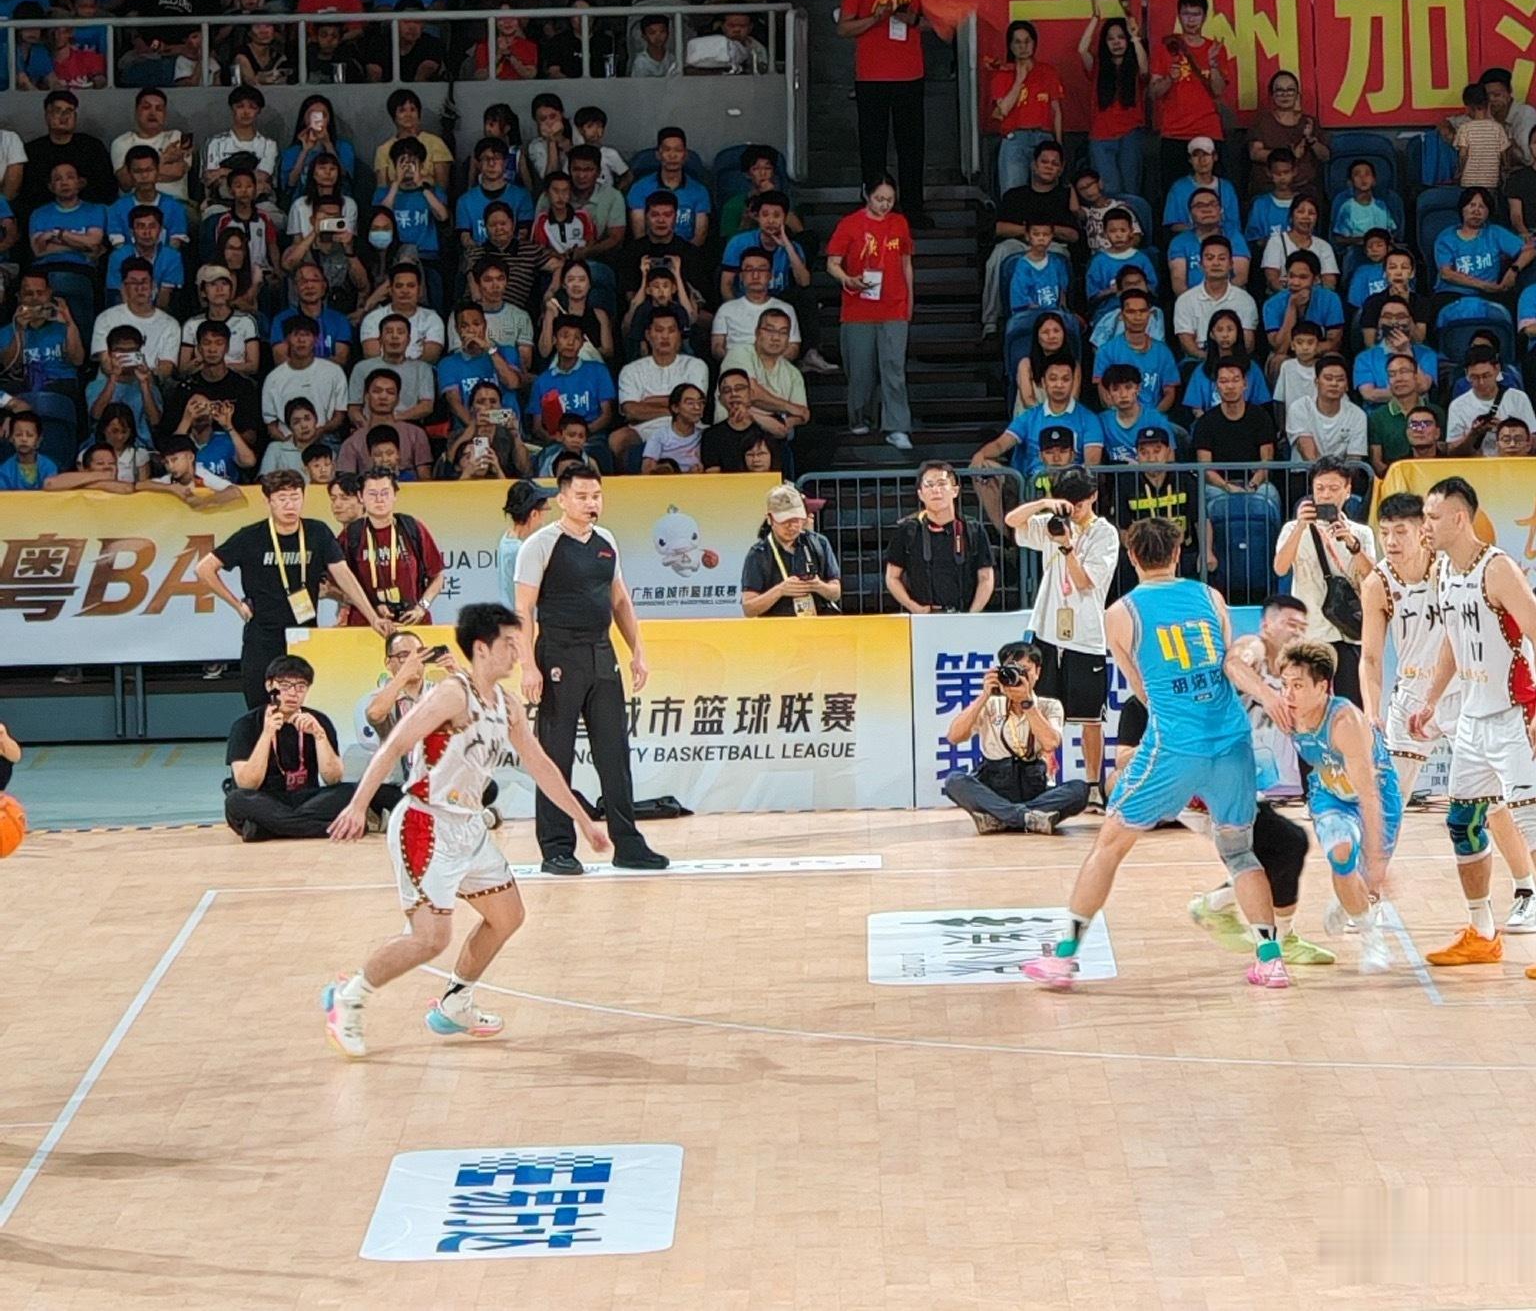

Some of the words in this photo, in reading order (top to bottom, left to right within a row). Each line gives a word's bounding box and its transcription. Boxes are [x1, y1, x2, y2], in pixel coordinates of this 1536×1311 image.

[2, 532, 217, 624] 粤BA
[654, 744, 776, 763] BASKETBALL
[781, 742, 856, 759] LEAGUE
